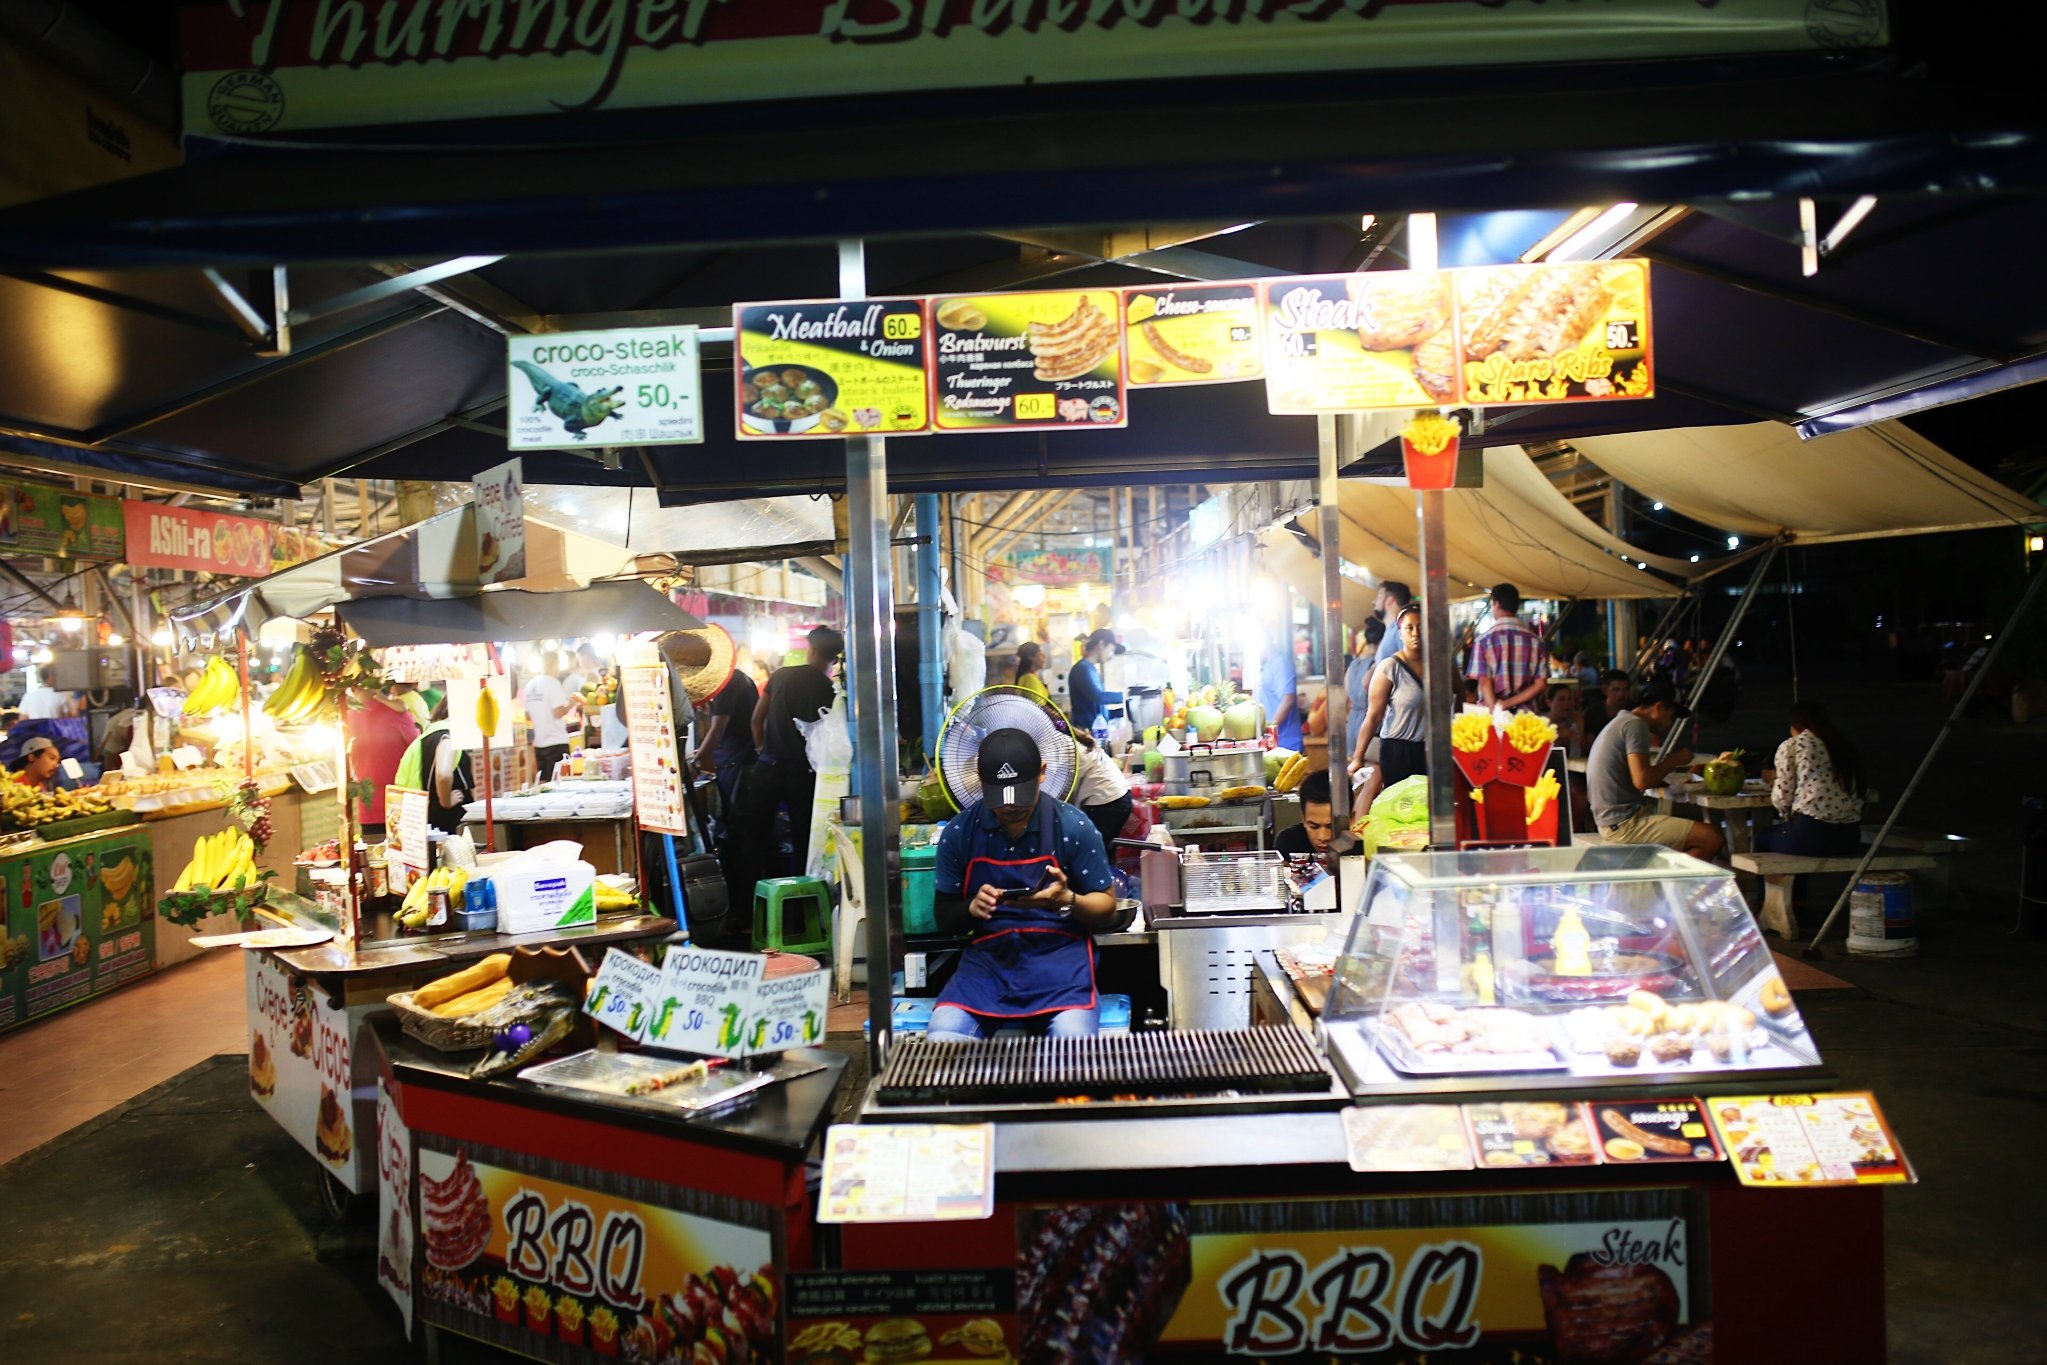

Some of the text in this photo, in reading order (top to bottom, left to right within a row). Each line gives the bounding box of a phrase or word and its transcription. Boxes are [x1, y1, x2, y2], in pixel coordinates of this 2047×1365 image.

[1273, 281, 1379, 332] Steak
[766, 304, 884, 341] Meatball
[886, 317, 921, 337] 60.-
[533, 334, 686, 364] croco-steak
[860, 340, 915, 357] & Onion
[939, 332, 1028, 354] Bratwurst
[570, 361, 677, 378] croco-Schaschlik
[1482, 347, 1614, 387] Spare Ribs
[637, 383, 689, 410] 50,-
[946, 372, 1013, 395] Thueringer
[150, 514, 211, 560] AShi-ra
[687, 982, 727, 995] crocodile
[694, 993, 715, 1009] BBQ
[1630, 1111, 1690, 1131] sausage
[502, 1187, 648, 1311] BBQ
[1591, 1215, 1688, 1267] Steak
[1221, 1239, 1482, 1357] BBQ
